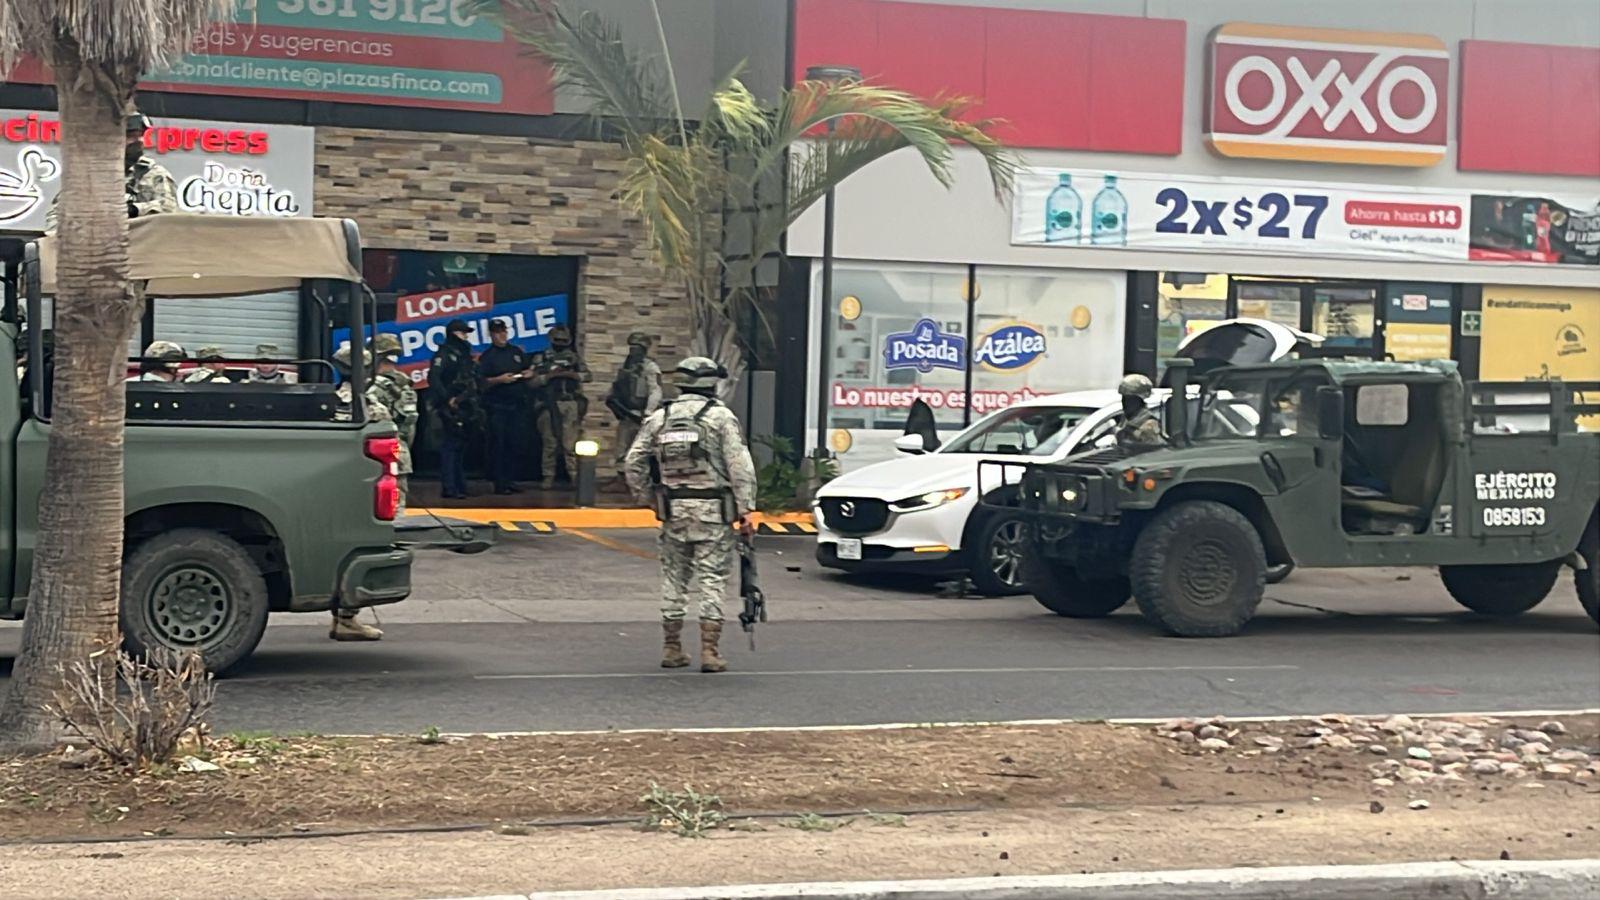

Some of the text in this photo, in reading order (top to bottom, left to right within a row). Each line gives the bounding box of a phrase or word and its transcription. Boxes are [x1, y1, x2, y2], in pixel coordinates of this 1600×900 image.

[242, 33, 254, 52] y
[259, 34, 393, 57] sugerencias
[1224, 55, 1438, 137] OXXO
[207, 164, 266, 188] Doña
[182, 177, 299, 215] Chepita
[1350, 208, 1457, 225] Ahorra hasta $14
[404, 290, 487, 318] LOCAL
[893, 340, 958, 363] Posada
[974, 331, 1046, 363] Azálea
[834, 385, 859, 406] Lo
[864, 388, 943, 408] nuestro
[971, 391, 1009, 413] que
[1475, 470, 1556, 488] EJÉRCITO
[1477, 488, 1555, 500] MEXICANO
